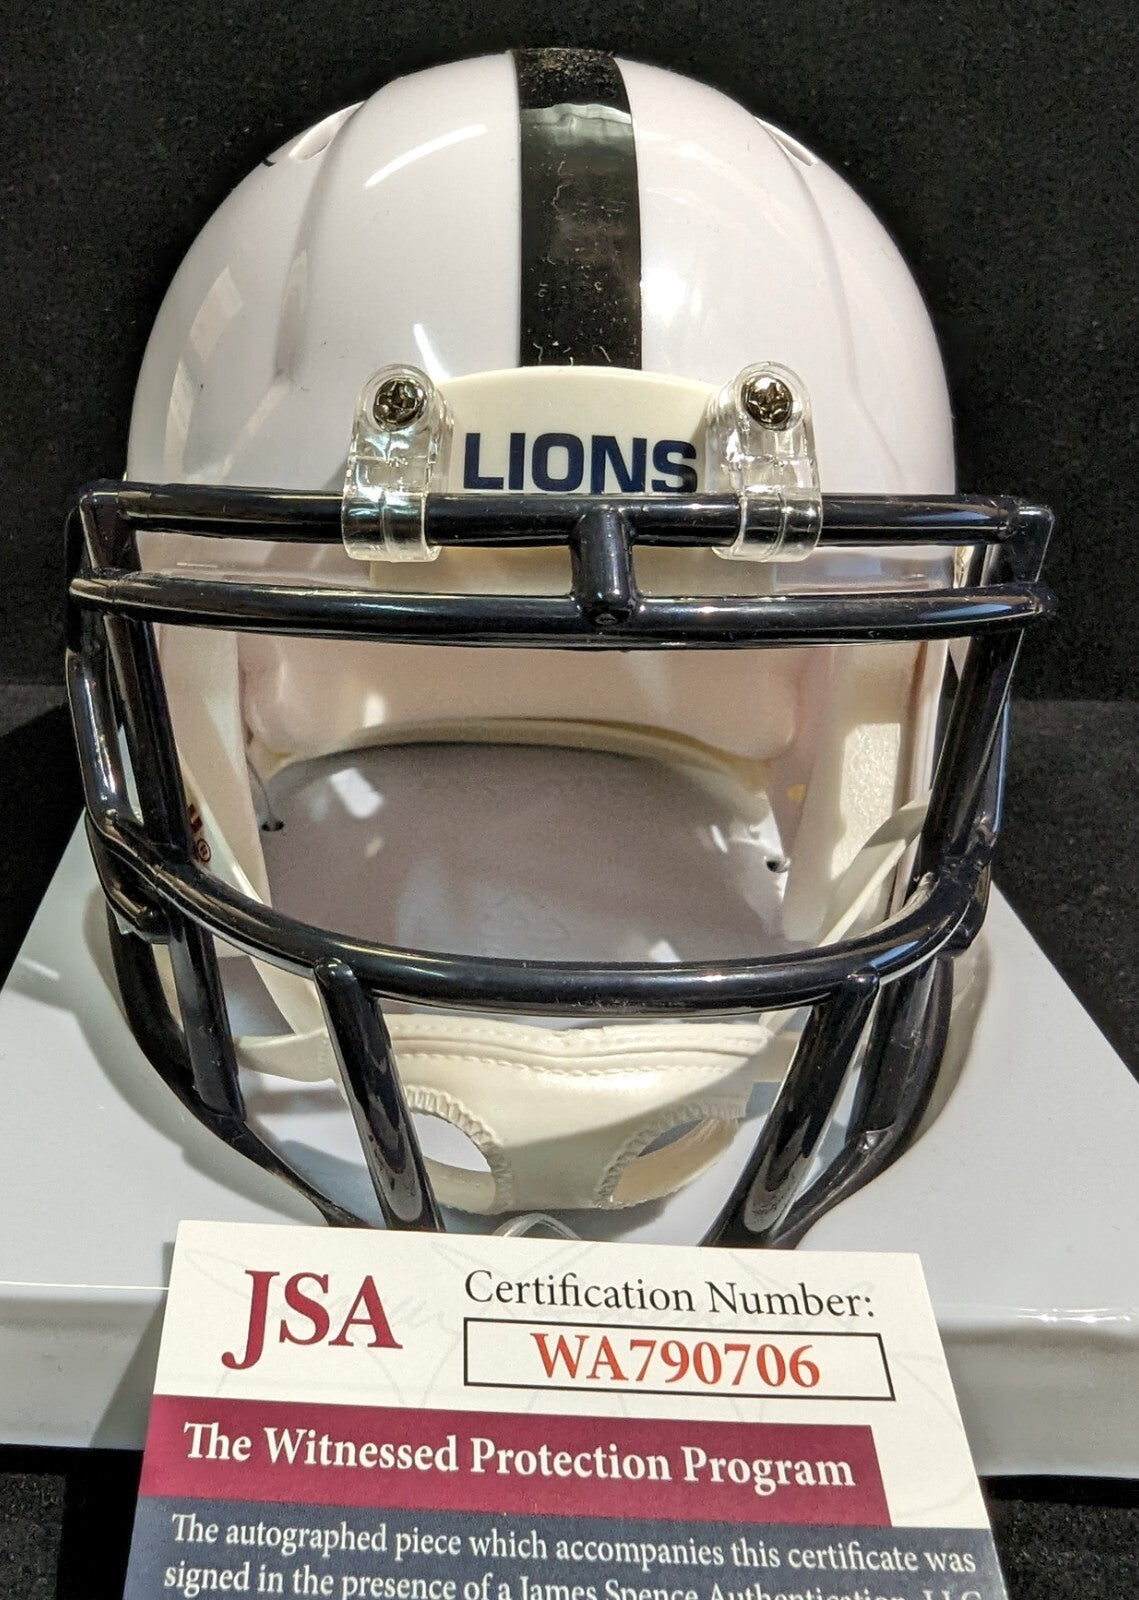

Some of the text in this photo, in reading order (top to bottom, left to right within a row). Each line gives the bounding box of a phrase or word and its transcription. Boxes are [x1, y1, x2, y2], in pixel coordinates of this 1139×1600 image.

[464, 433, 697, 493] LIONS
[222, 1270, 402, 1369] JSA
[466, 1271, 873, 1316] Certification Number:
[530, 1334, 819, 1387] WA790706
[184, 1422, 855, 1496] The Witnessed Protection Program
[172, 1513, 976, 1573] The autographed piece which accompanies this certificate was
[164, 1561, 250, 1598] signed
[258, 1564, 283, 1593] in
[293, 1565, 333, 1596] the
[342, 1576, 456, 1600] presence
[464, 1572, 493, 1600] of
[498, 1583, 512, 1600] a
[520, 1576, 597, 1600] James
